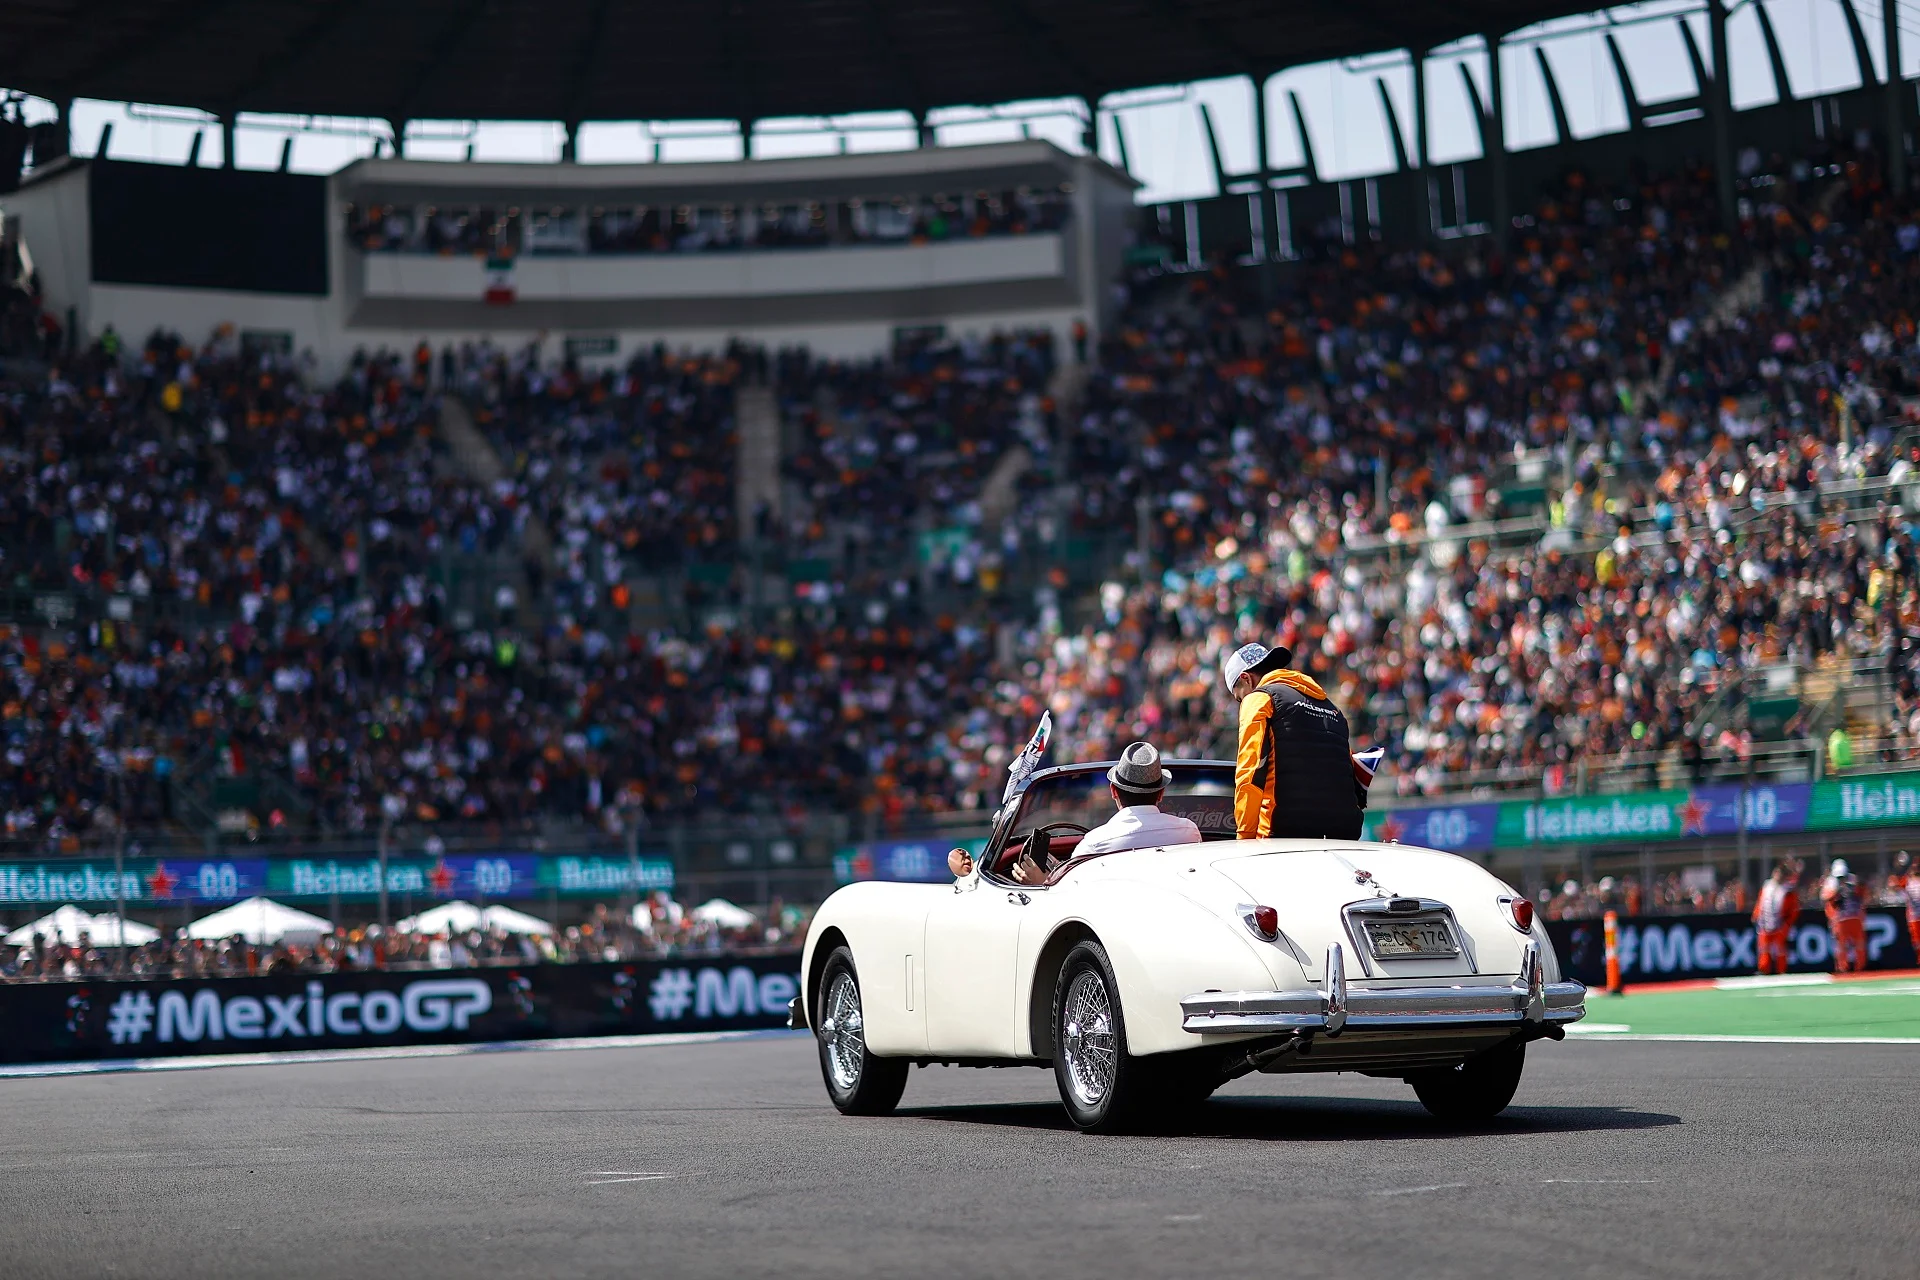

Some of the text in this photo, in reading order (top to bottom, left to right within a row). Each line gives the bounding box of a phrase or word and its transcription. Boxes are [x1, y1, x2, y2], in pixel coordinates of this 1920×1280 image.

[1294, 700, 1338, 717] McLaren
[0, 864, 142, 900] Heineken
[107, 978, 492, 1045] #MexicoGP
[648, 965, 801, 1020] #Me
